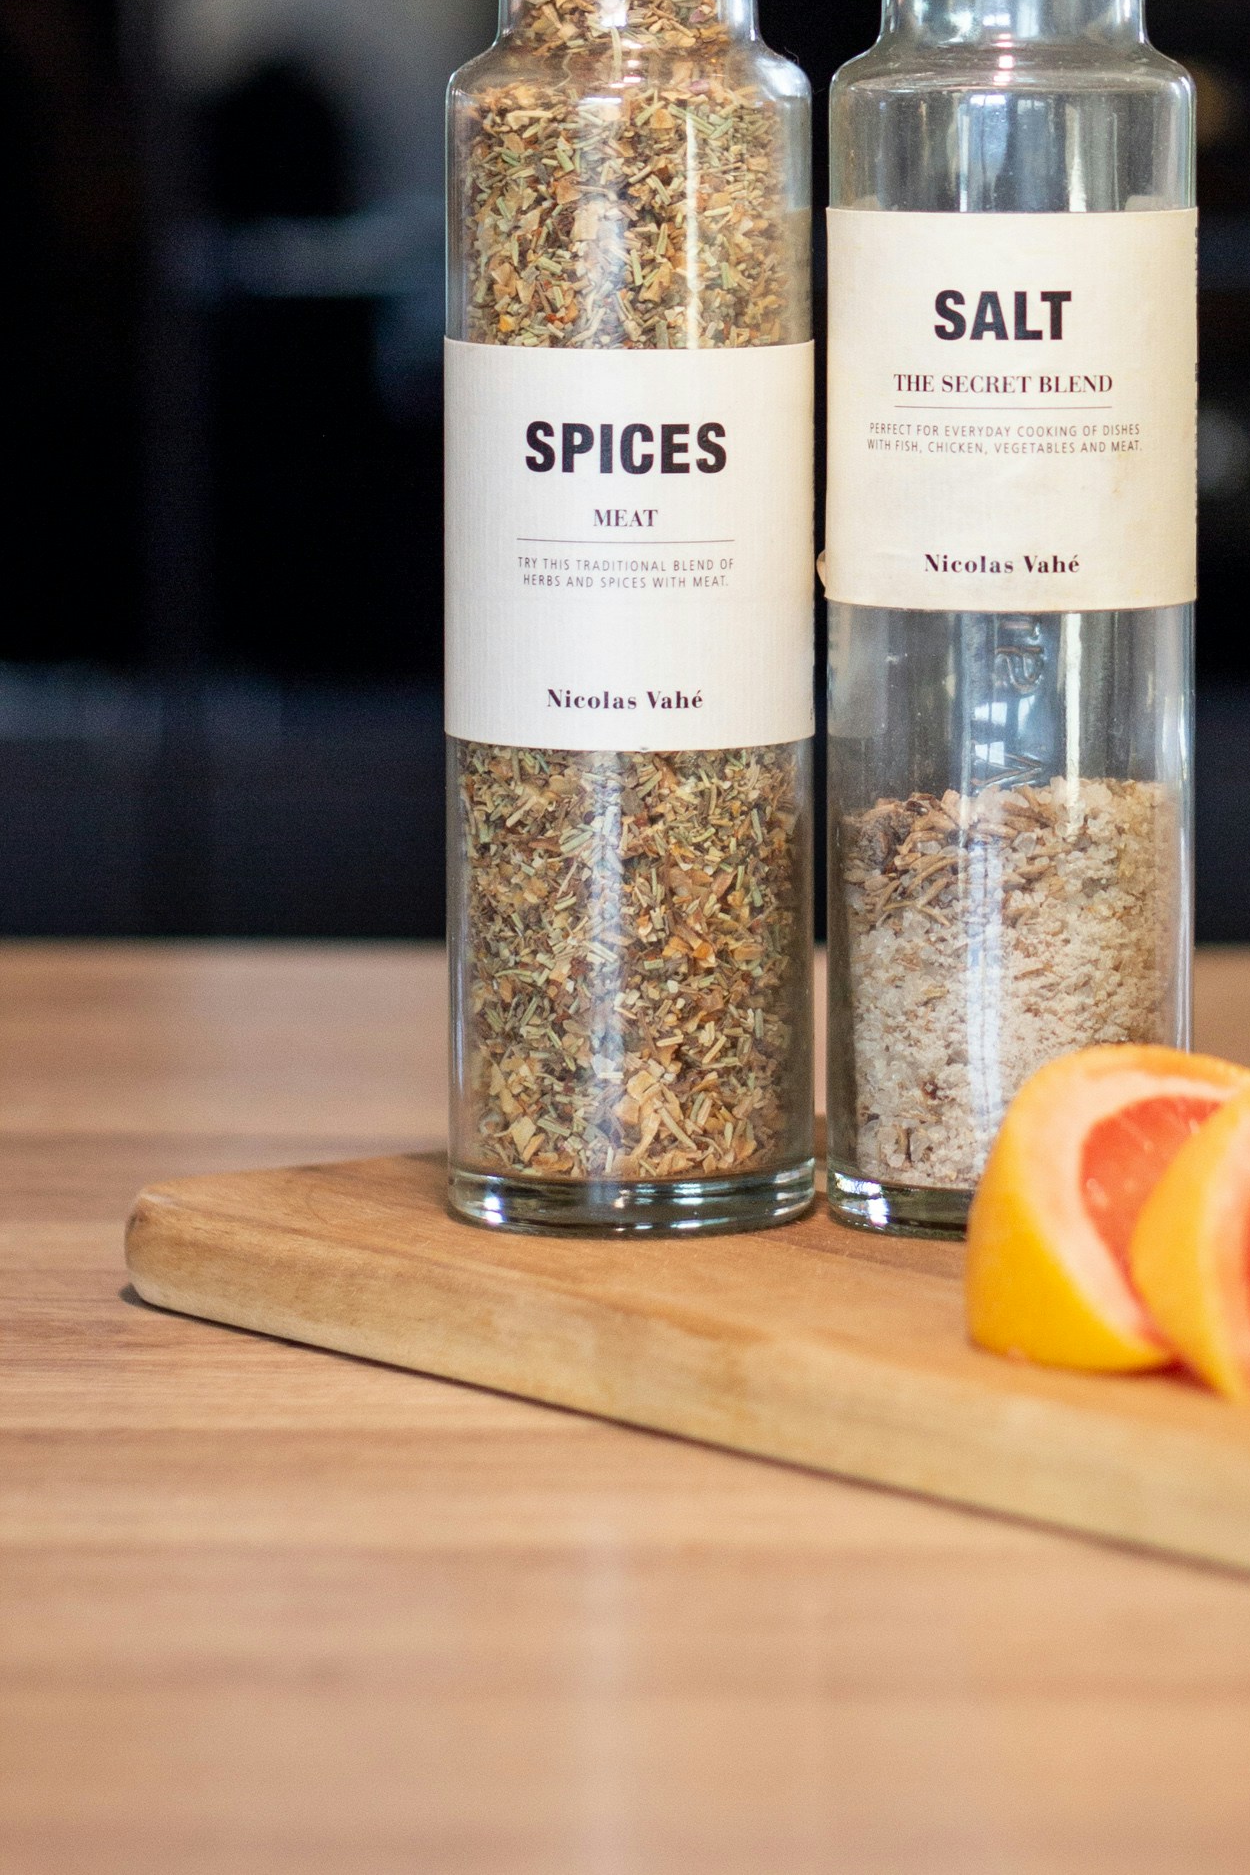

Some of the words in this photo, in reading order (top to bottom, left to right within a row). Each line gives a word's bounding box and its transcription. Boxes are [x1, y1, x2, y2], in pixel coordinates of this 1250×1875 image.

[934, 290, 1072, 340] SALT
[894, 374, 934, 393] THE
[942, 375, 1031, 393] SECRET
[1039, 375, 1112, 392] BLEND
[869, 423, 912, 436] PERFECT
[916, 424, 939, 436] FOR
[945, 425, 1011, 437] EVERYDAY
[1017, 425, 1077, 437] COOKING
[1083, 424, 1098, 436] OF
[1103, 423, 1140, 435] DISHES
[525, 421, 727, 474] SPICES
[867, 438, 891, 450] WITH
[895, 440, 922, 453] FISH,
[928, 441, 987, 455] CHICKEN,
[994, 441, 1075, 453] VEGETABLES
[1081, 441, 1106, 453] AND
[1111, 440, 1143, 452] MEAT.
[593, 509, 658, 527] MEAT
[518, 557, 537, 568] TRY
[543, 558, 570, 570] THIS
[576, 559, 666, 571] TRADITIONAL
[673, 559, 714, 571] BLEND
[720, 558, 734, 569] OF
[924, 554, 1014, 573] Nicolas
[1023, 555, 1080, 573] Vahé
[523, 574, 561, 586] HERBS
[567, 575, 594, 587] AND
[600, 576, 646, 588] SPICES
[653, 576, 686, 588] WITH
[692, 575, 729, 587] MEAT.
[547, 689, 637, 709] Nicolas
[646, 690, 703, 709] Vahé
